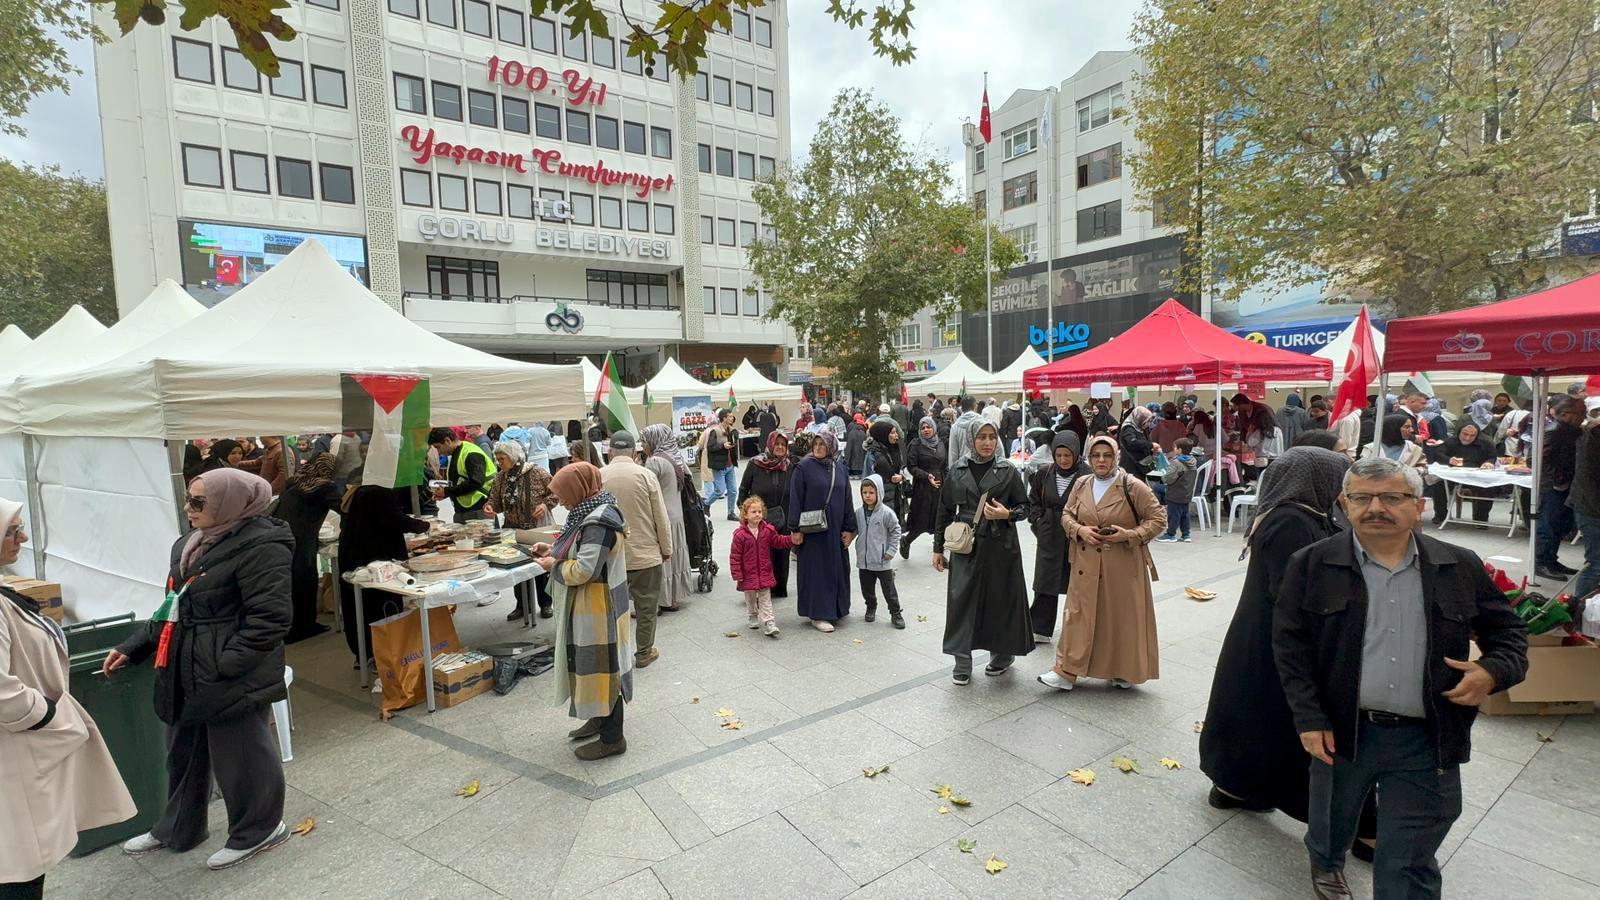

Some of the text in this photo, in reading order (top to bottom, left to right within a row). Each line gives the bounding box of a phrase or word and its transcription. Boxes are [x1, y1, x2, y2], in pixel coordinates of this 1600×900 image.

[488, 55, 556, 96] 100.
[401, 125, 527, 174] Yaşasın
[418, 214, 515, 243] ÇORLU
[1083, 277, 1138, 298] SAĞLIK
[1029, 322, 1090, 345] beko
[1272, 331, 1341, 348] TURKCE
